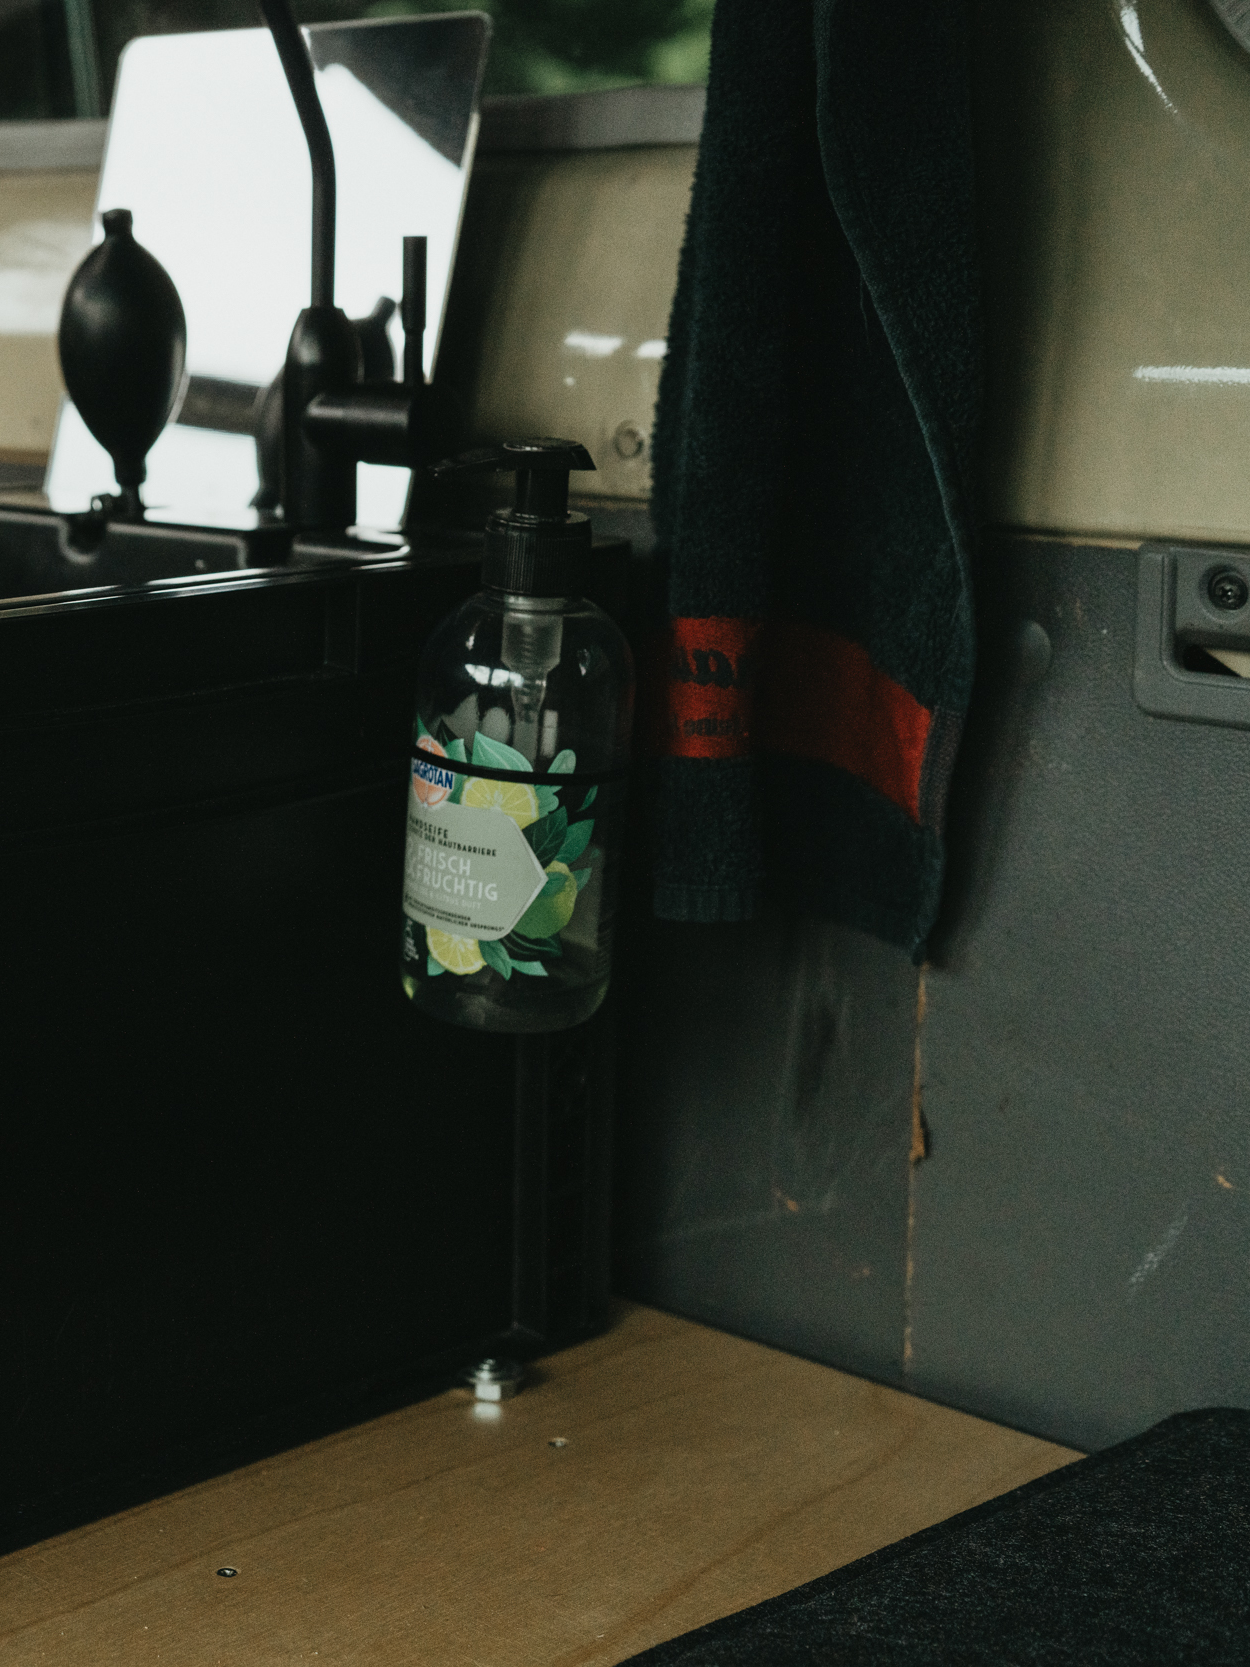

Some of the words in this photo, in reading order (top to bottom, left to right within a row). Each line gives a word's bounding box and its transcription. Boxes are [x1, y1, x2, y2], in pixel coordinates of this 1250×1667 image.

[413, 759, 454, 790] AGROTAN
[417, 844, 471, 876] FRISCH
[438, 839, 497, 857] HAUTBARRIERE
[415, 864, 498, 901] FRUCHTIG
